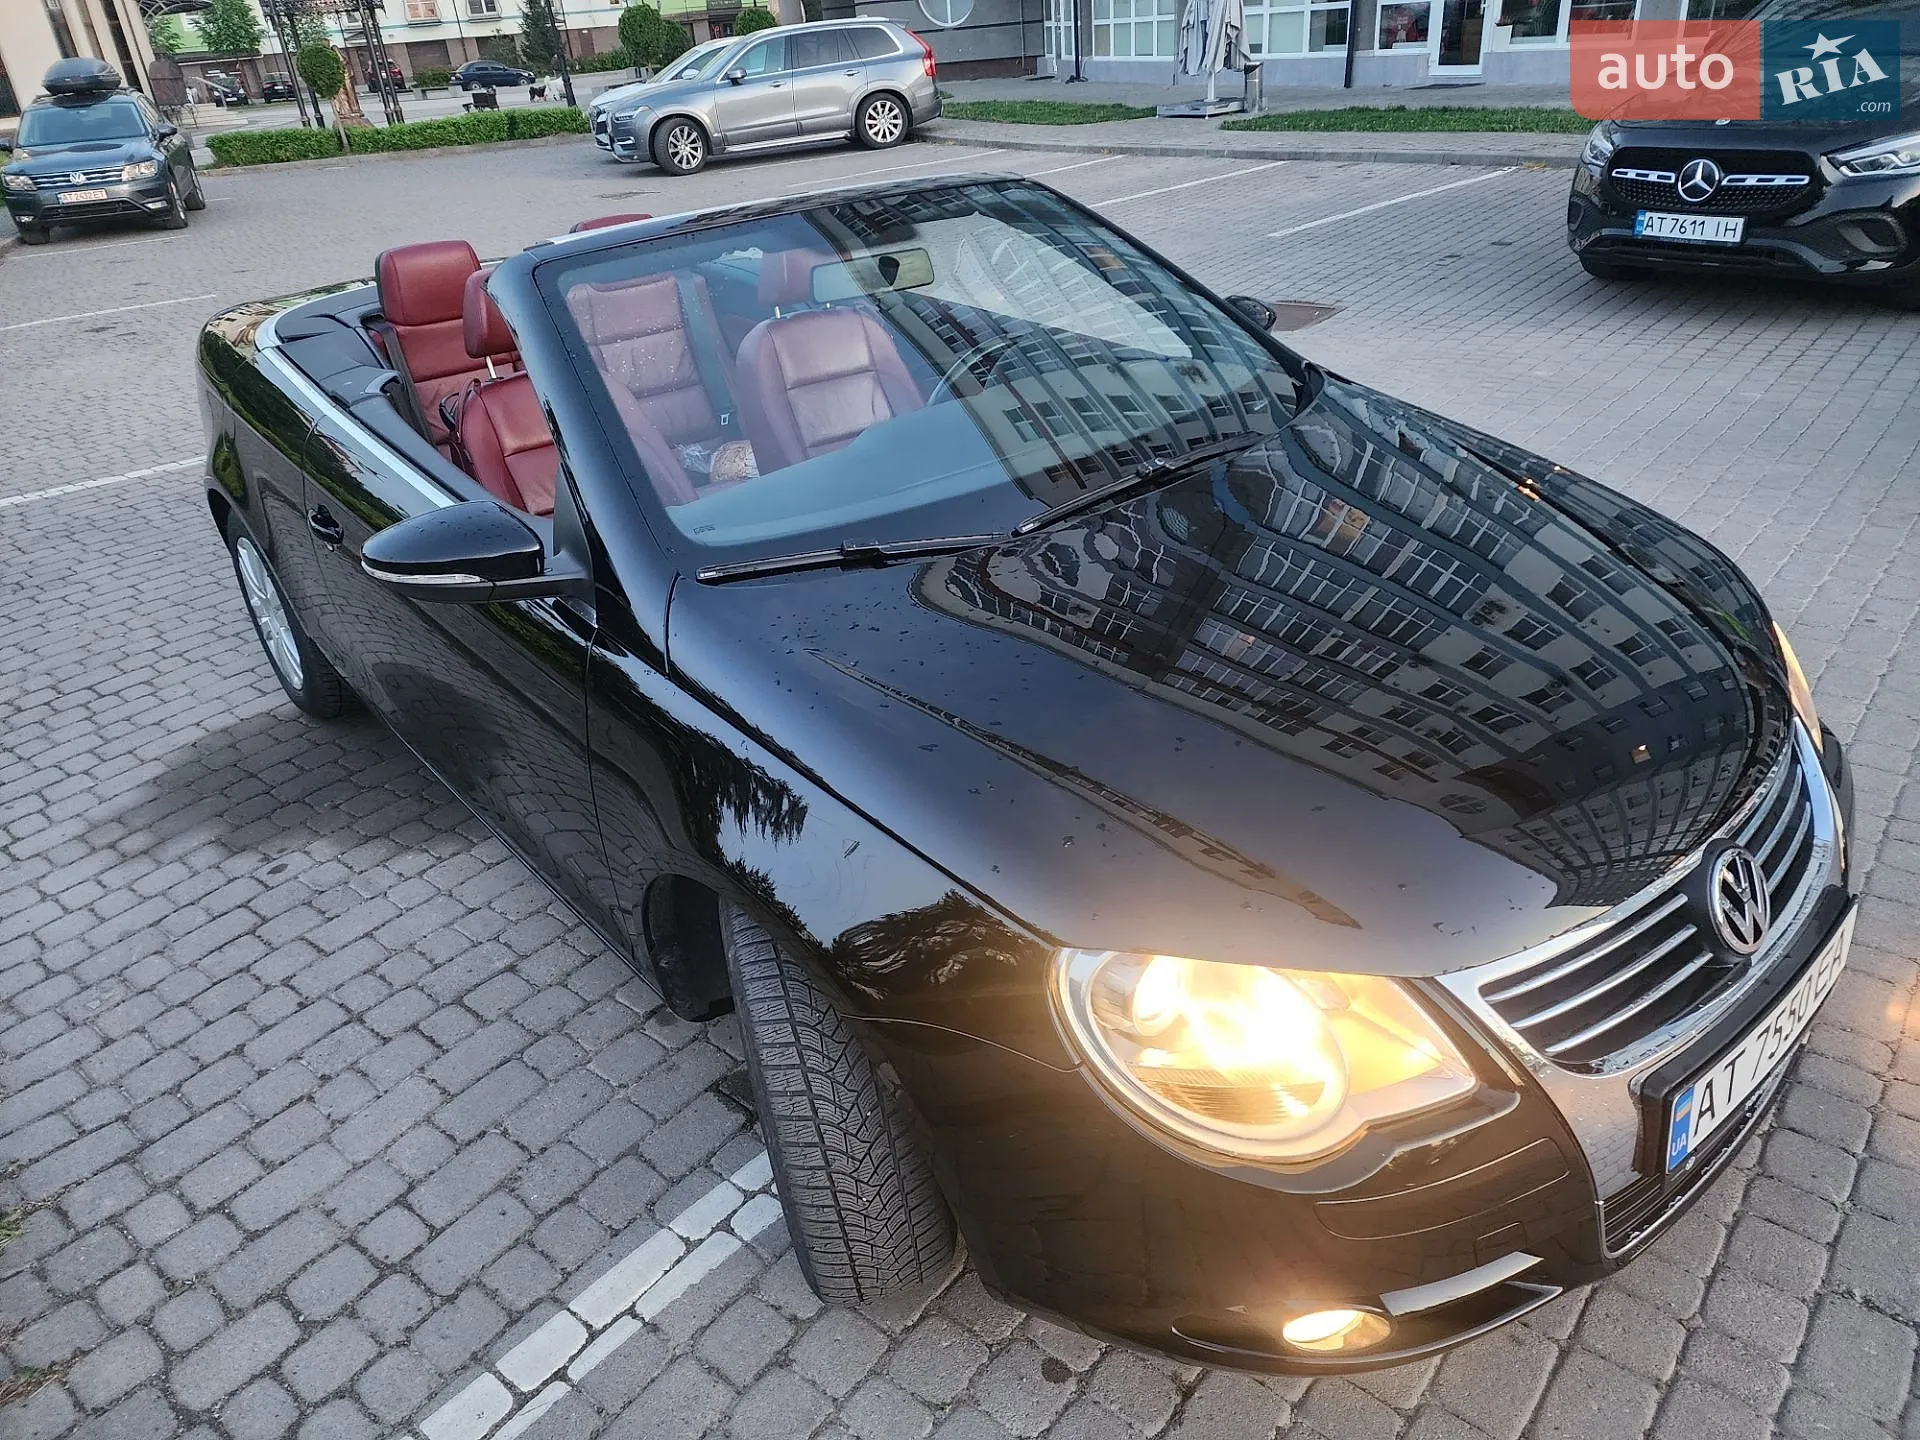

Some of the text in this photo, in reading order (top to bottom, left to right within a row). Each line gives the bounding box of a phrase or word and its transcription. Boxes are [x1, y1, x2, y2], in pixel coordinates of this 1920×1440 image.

[1644, 216, 1667, 233] AT
[1670, 218, 1705, 236] 7611
[1715, 221, 1738, 238] IH
[1693, 1048, 1747, 1137] AT
[1671, 1133, 1687, 1156] UA
